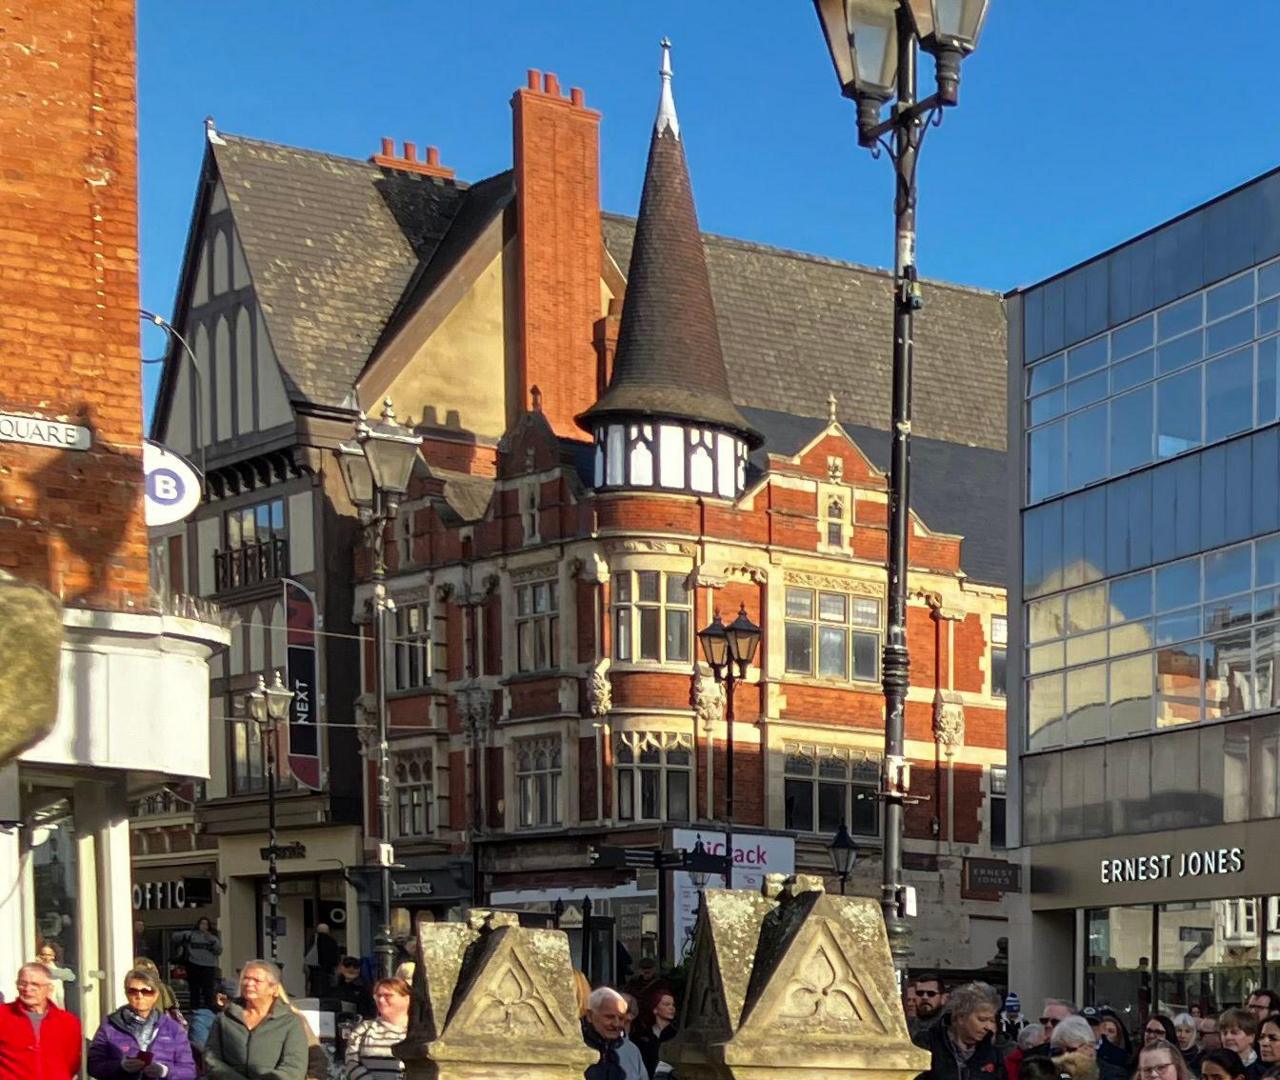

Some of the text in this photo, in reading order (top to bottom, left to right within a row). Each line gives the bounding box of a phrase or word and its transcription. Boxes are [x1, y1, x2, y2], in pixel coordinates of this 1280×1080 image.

[295, 679, 309, 724] NEXT
[706, 841, 767, 864] iCack
[1101, 848, 1244, 883] ERNEST JONES
[133, 881, 197, 910] OFFIC
